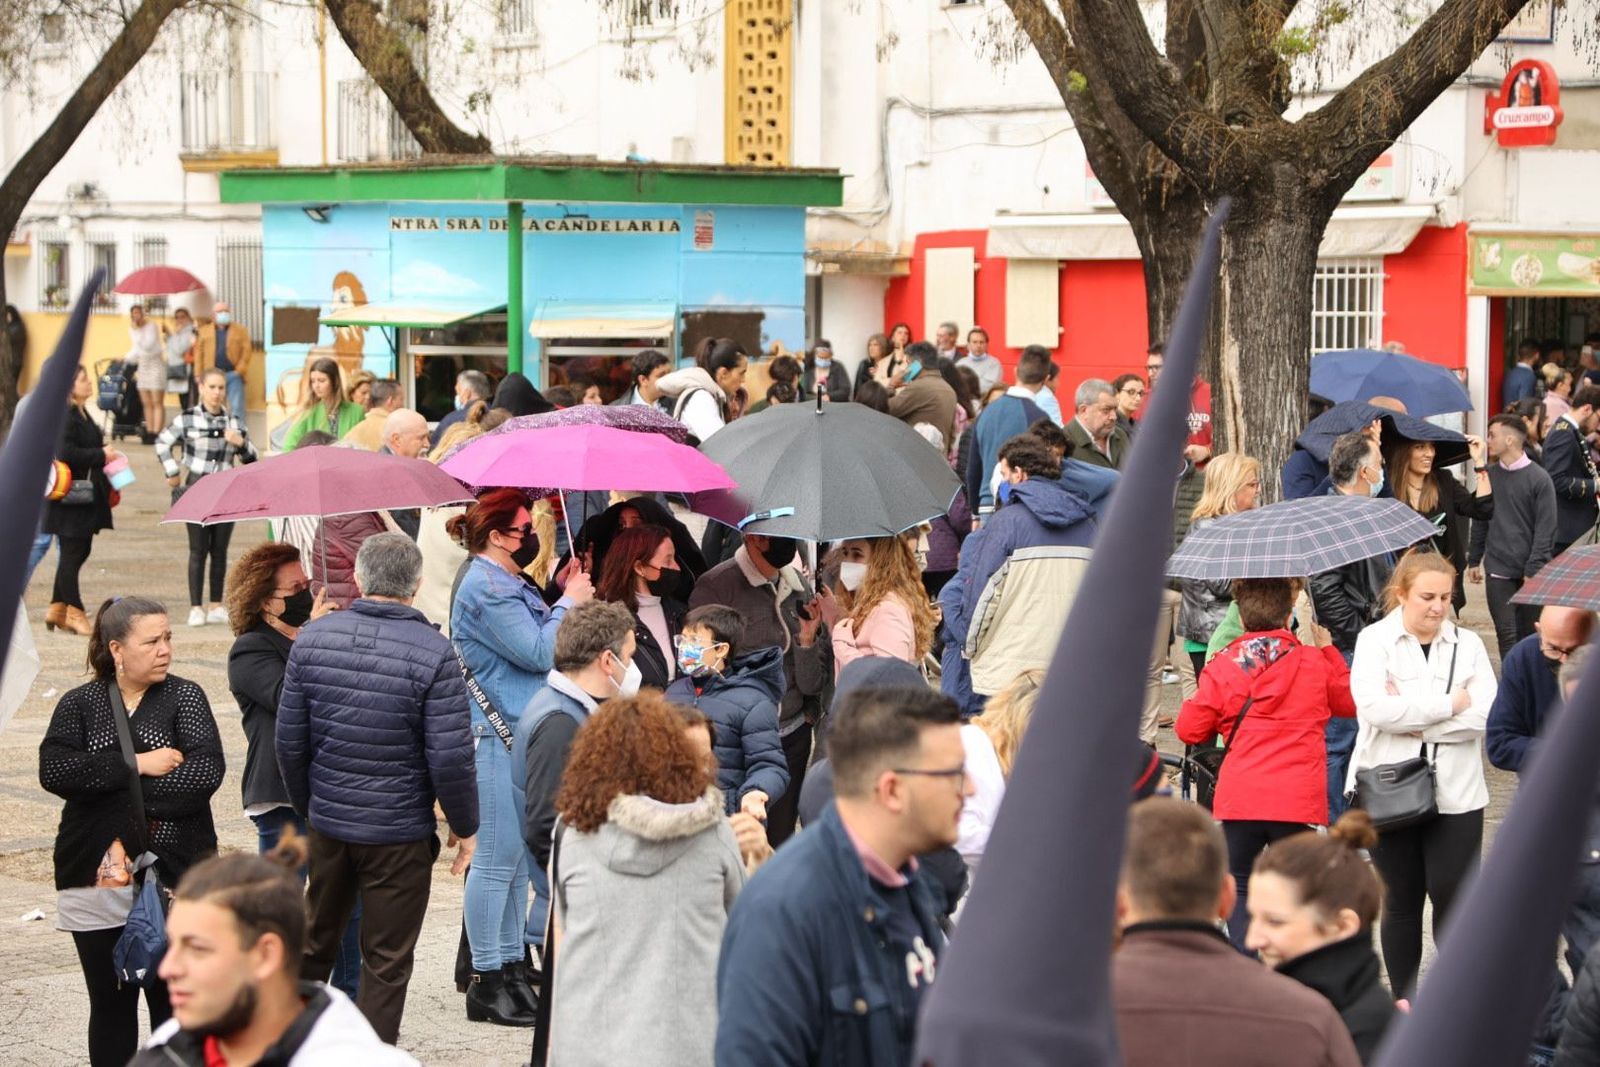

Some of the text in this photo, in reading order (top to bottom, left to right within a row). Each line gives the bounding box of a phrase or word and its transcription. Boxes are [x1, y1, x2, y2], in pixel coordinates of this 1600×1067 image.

[391, 218, 439, 230] NTRA
[446, 218, 481, 230] SRA
[545, 219, 680, 231] CANDELARIA
[466, 678, 514, 746] BIMBA BIMBA
